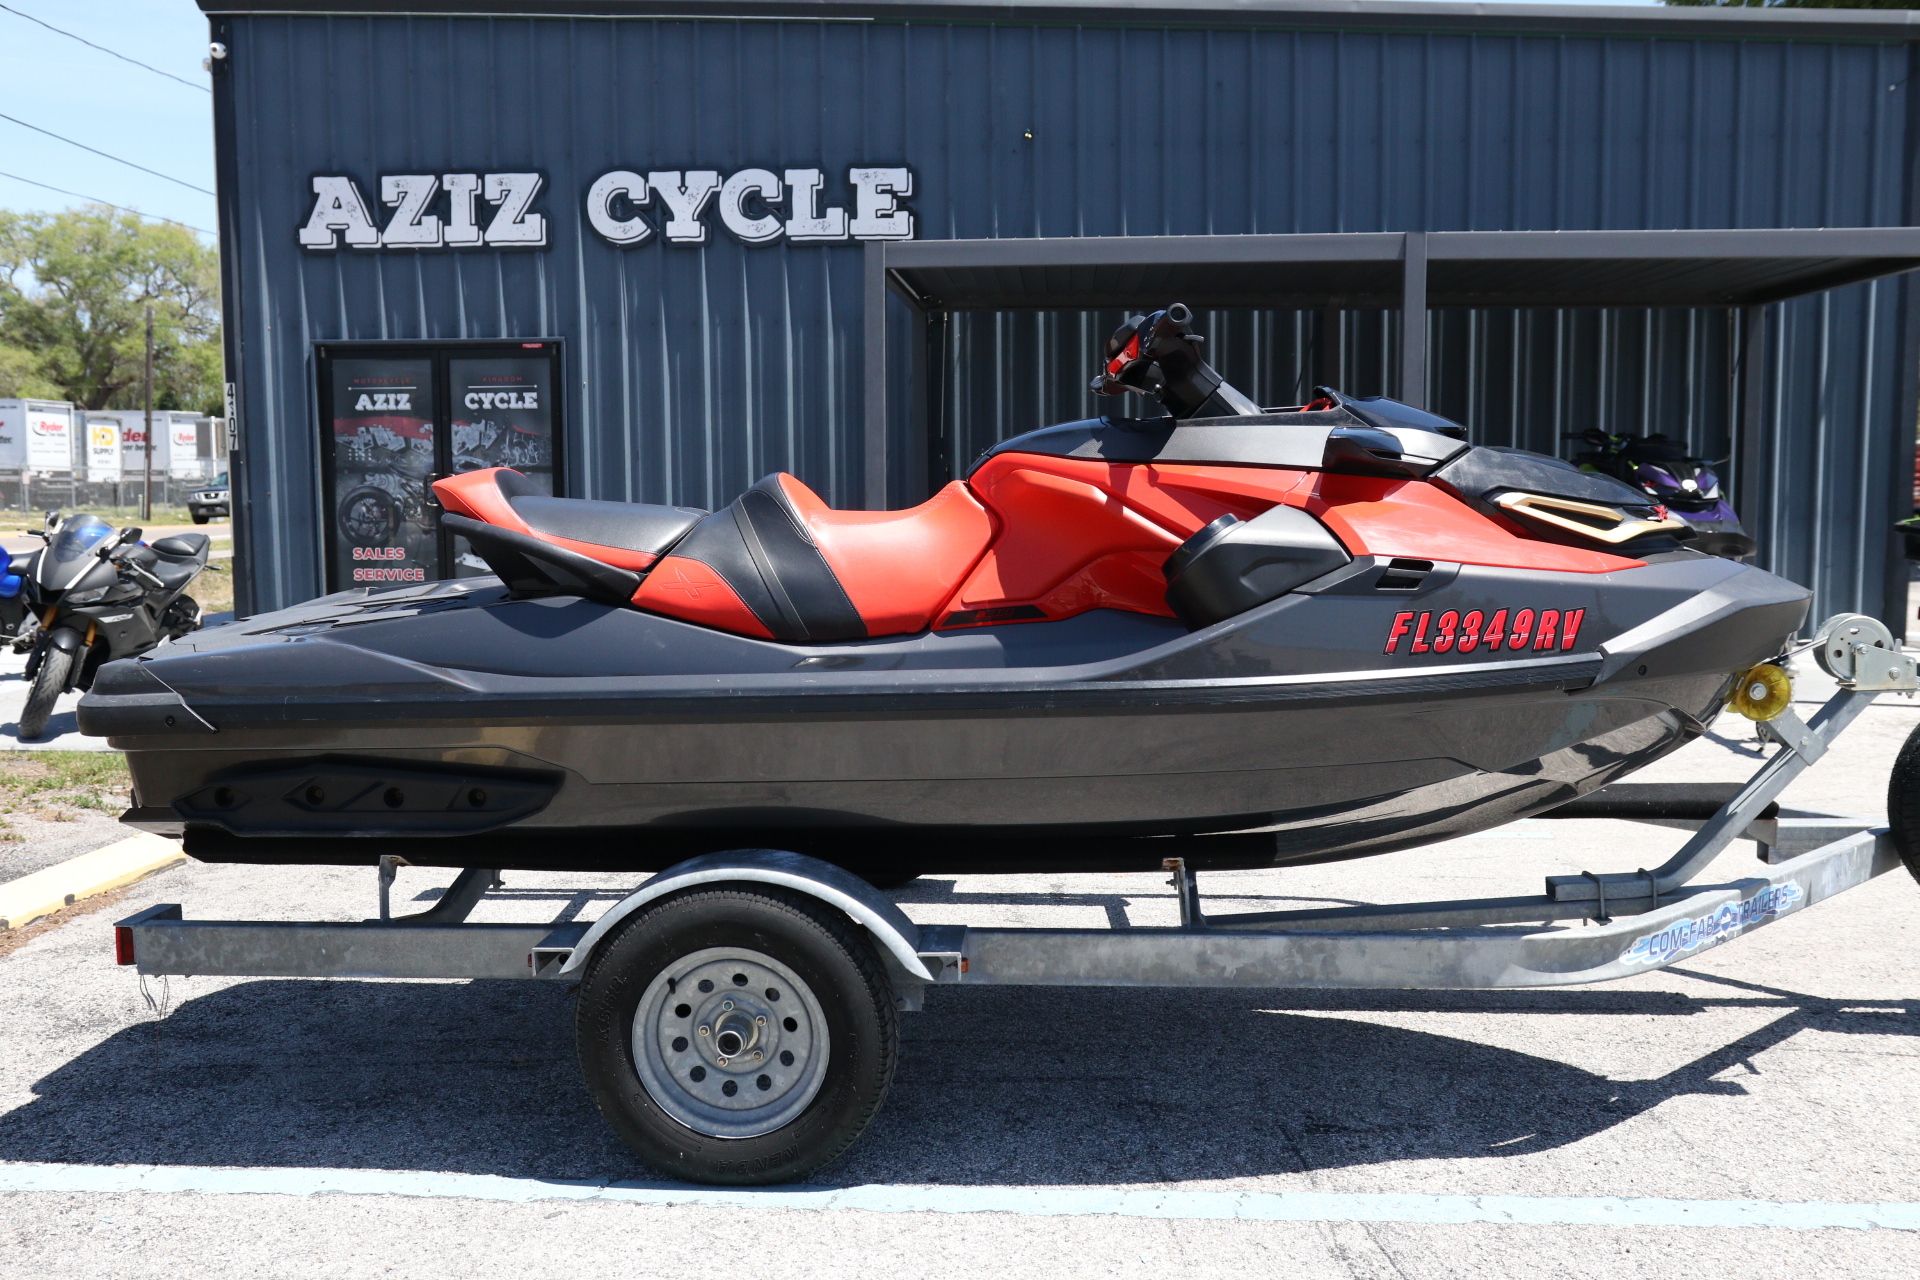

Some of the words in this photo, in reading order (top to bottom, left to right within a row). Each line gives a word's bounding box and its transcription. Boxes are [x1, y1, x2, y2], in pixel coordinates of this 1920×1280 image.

[299, 172, 548, 248] AZIZ
[586, 167, 914, 245] CYCLE
[355, 393, 411, 411] AZIZ
[464, 392, 538, 410] CYCLE
[39, 421, 63, 433] Ryder
[93, 447, 114, 455] SUPPLY
[353, 547, 406, 560] SALES
[353, 568, 425, 581] SERVICE
[1382, 607, 1587, 656] FL3349RV
[1736, 884, 1789, 925] TRAILERS
[716, 1143, 800, 1175] KENDA
